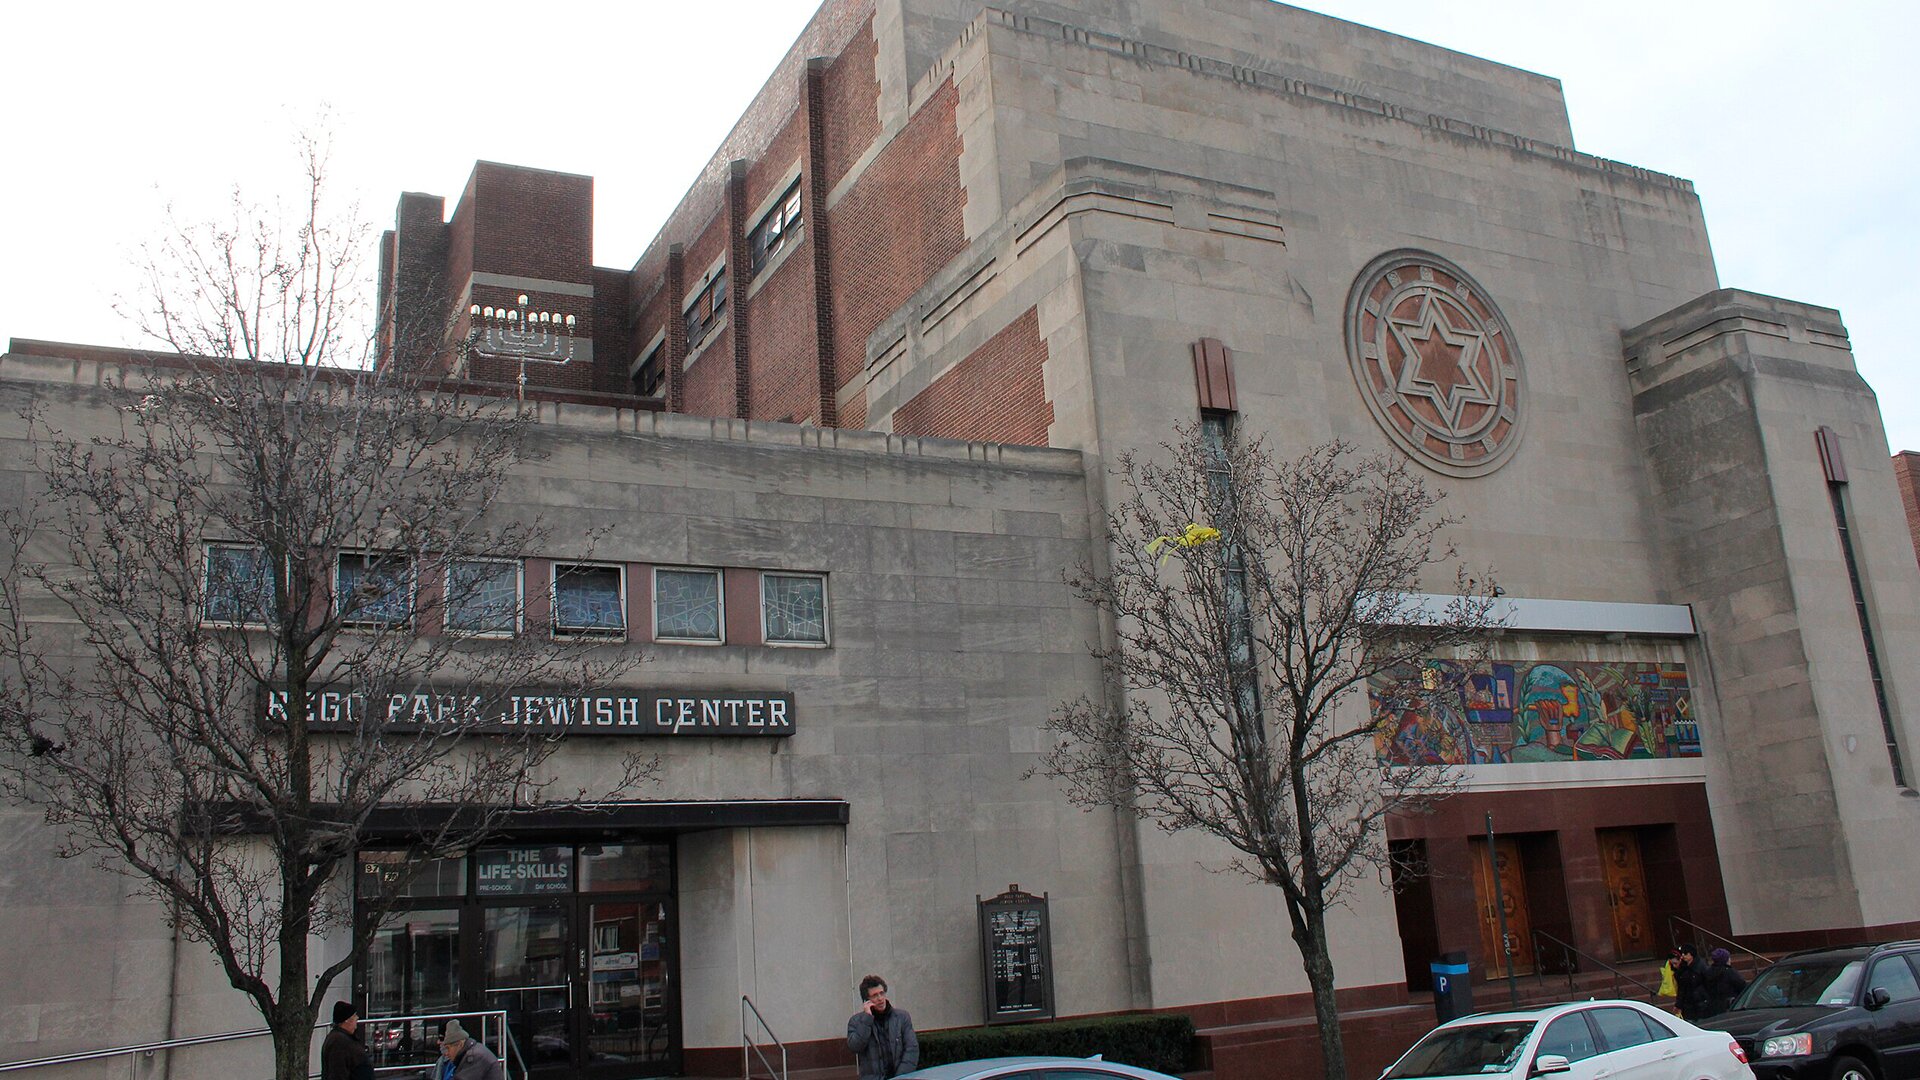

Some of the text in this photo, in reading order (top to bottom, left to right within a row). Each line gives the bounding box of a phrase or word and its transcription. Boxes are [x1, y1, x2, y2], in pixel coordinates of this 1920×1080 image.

[386, 693, 481, 724] PARK
[501, 696, 639, 726] JEWISH
[656, 698, 789, 727] CENTER
[508, 849, 541, 862] THE
[366, 864, 379, 873] 97
[479, 863, 568, 879] LIFE-SKILLS
[1439, 976, 1447, 992] P
